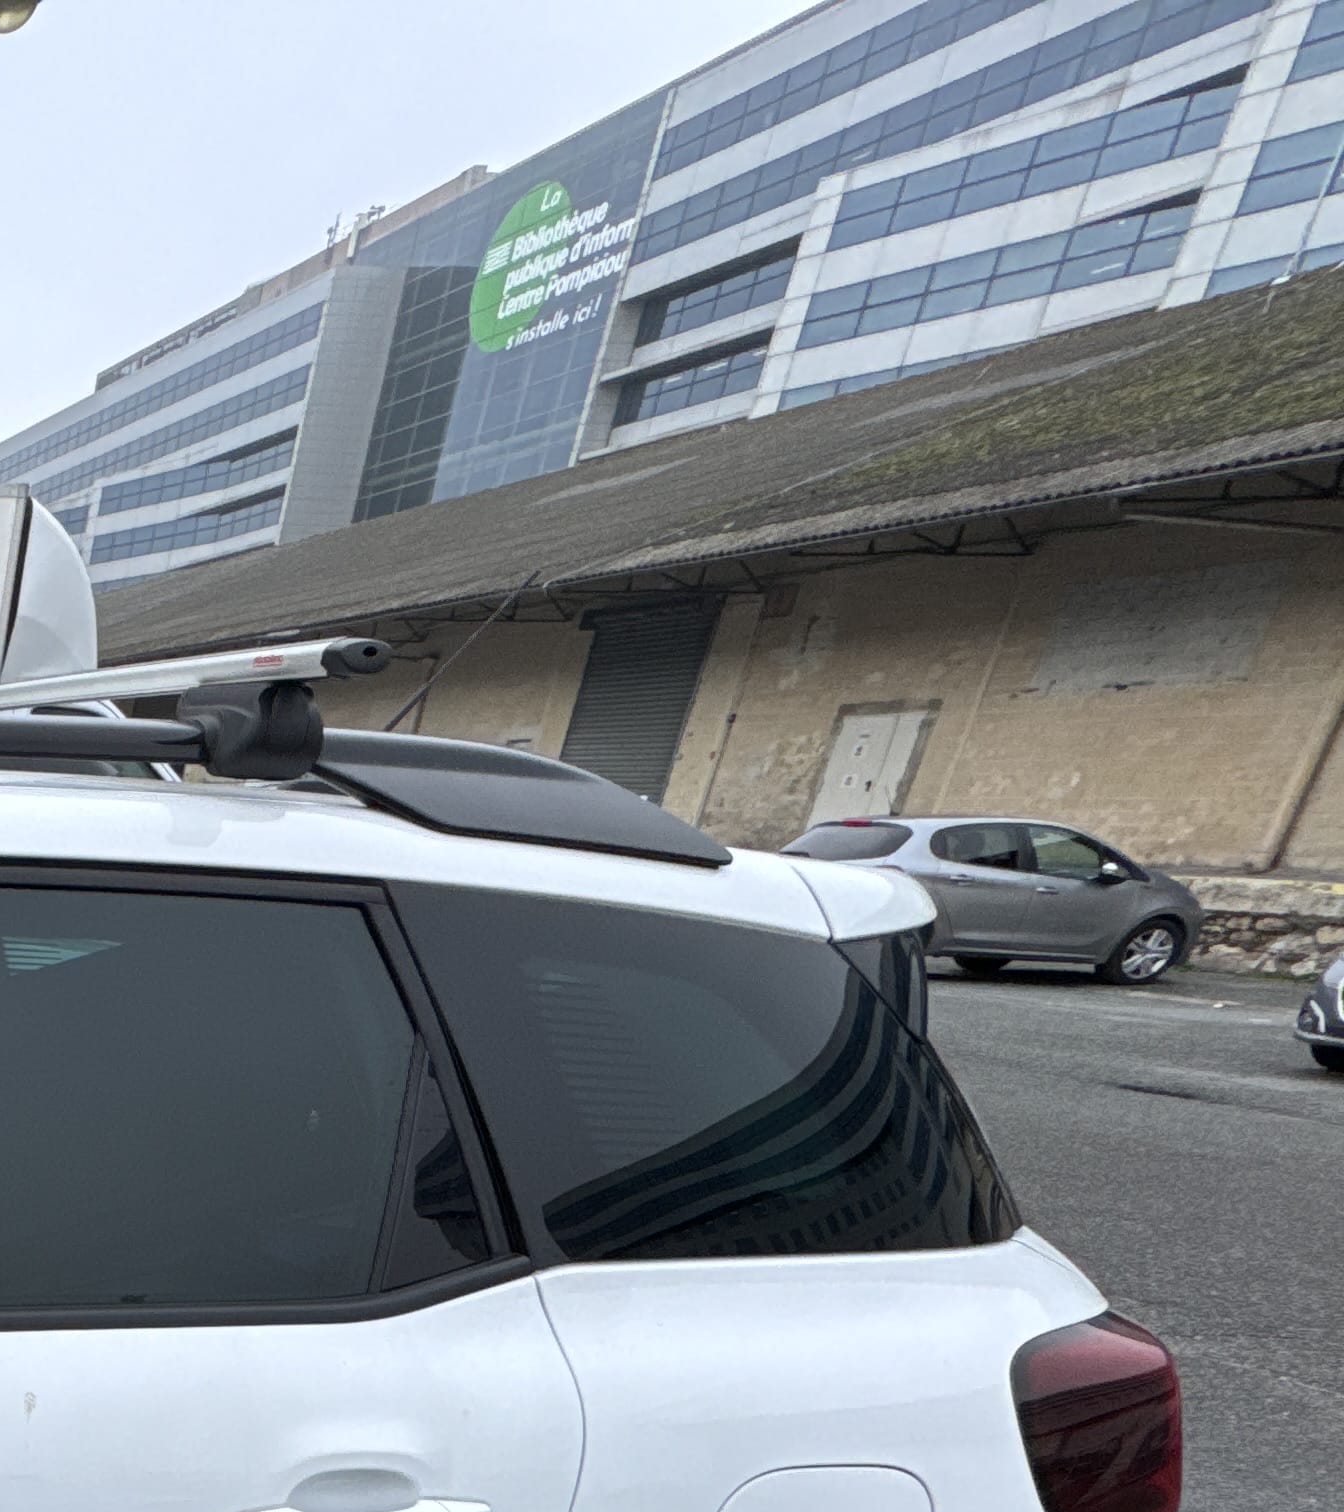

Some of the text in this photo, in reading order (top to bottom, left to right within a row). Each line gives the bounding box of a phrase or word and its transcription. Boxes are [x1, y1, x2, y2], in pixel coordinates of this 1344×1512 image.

[540, 188, 562, 213] La
[502, 247, 569, 297] publique
[497, 285, 545, 319] Centre
